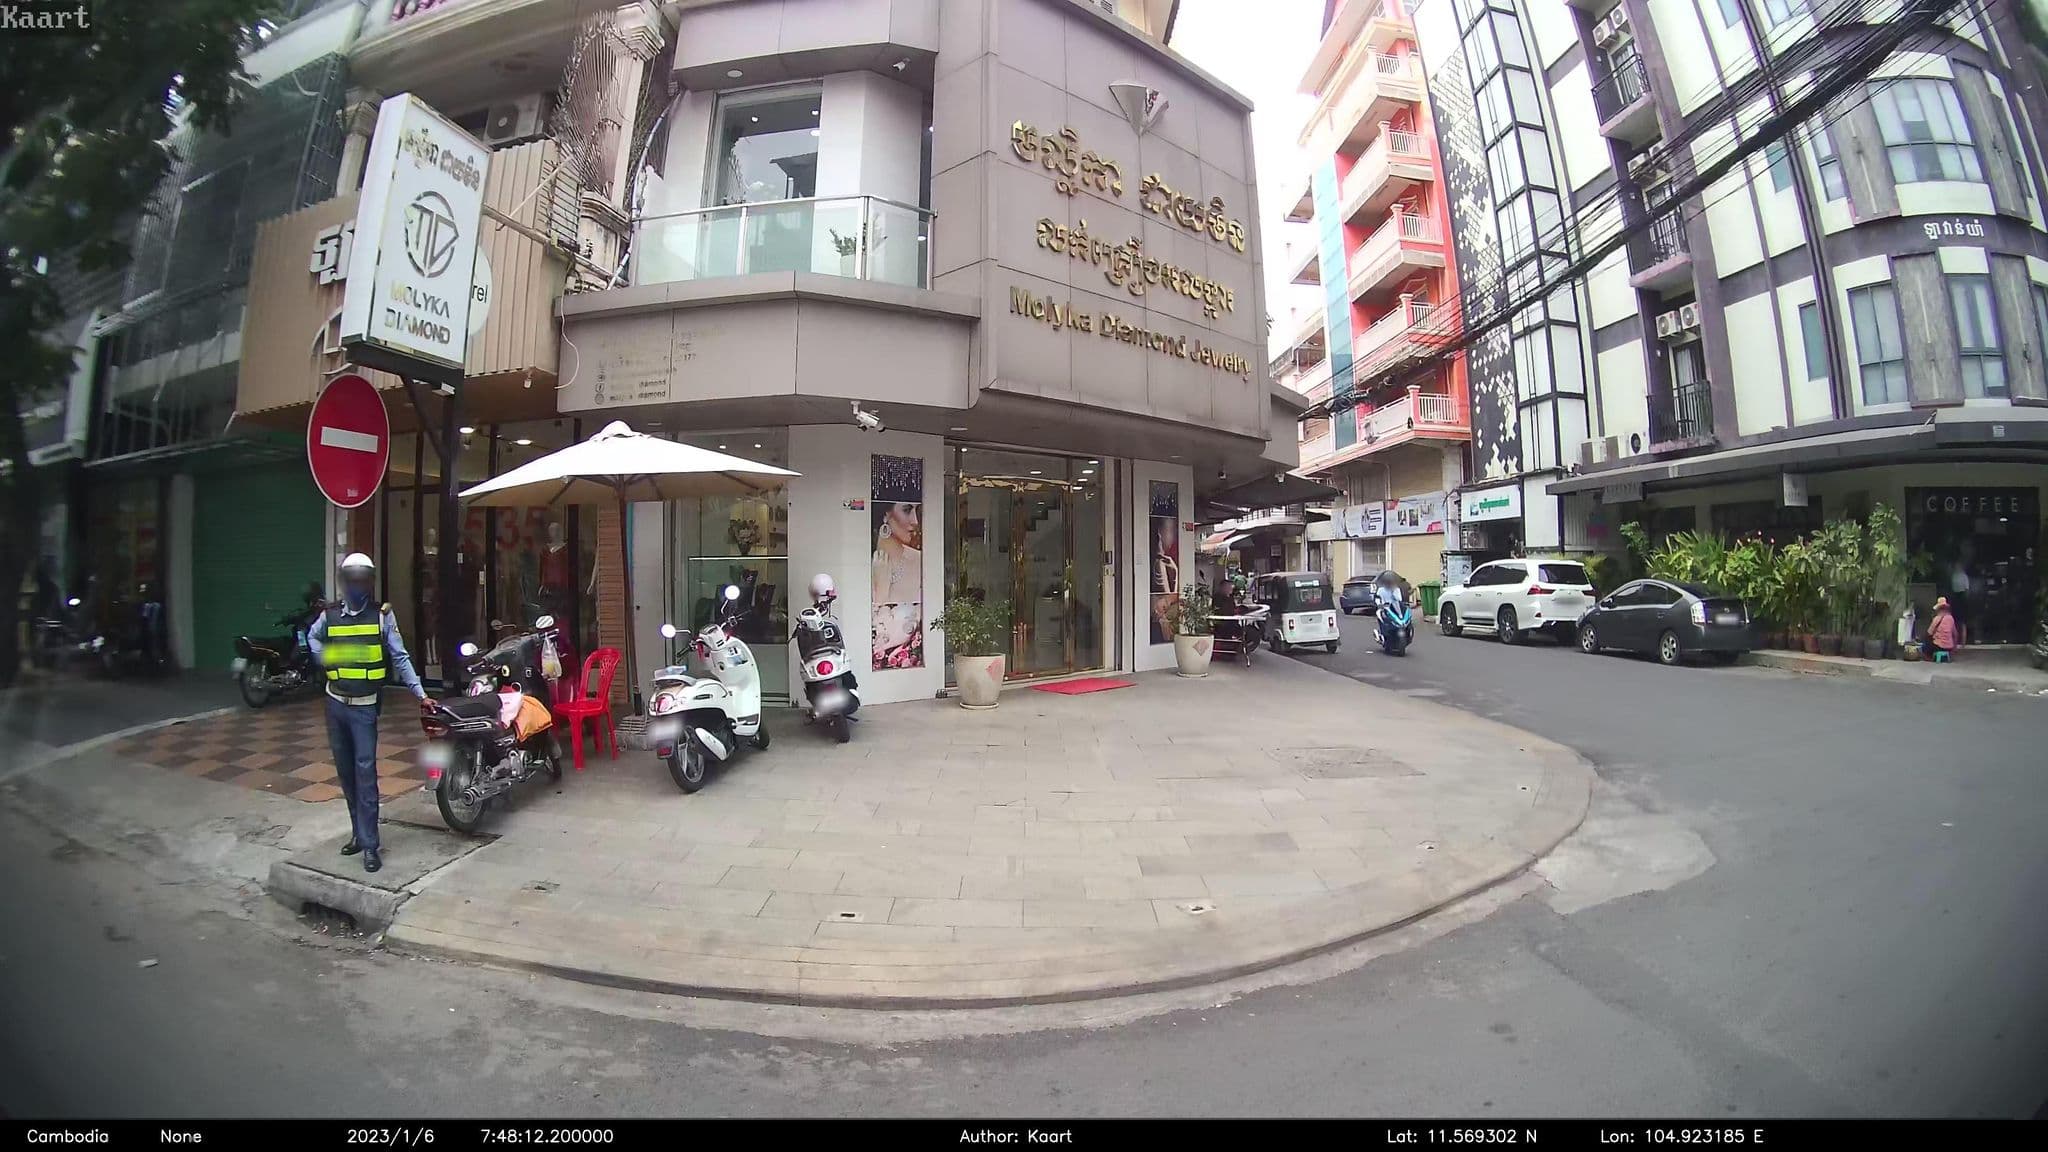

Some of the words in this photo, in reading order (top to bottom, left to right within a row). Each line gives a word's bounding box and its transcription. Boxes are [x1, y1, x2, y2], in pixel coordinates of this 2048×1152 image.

[390, 280, 450, 319] MOLYKA
[384, 307, 451, 344] DIAMOND
[1009, 286, 1093, 331] Molyka
[1099, 311, 1186, 359] Diamond
[1190, 339, 1252, 382] Jewelry
[1926, 495, 2020, 513] COFFEE
